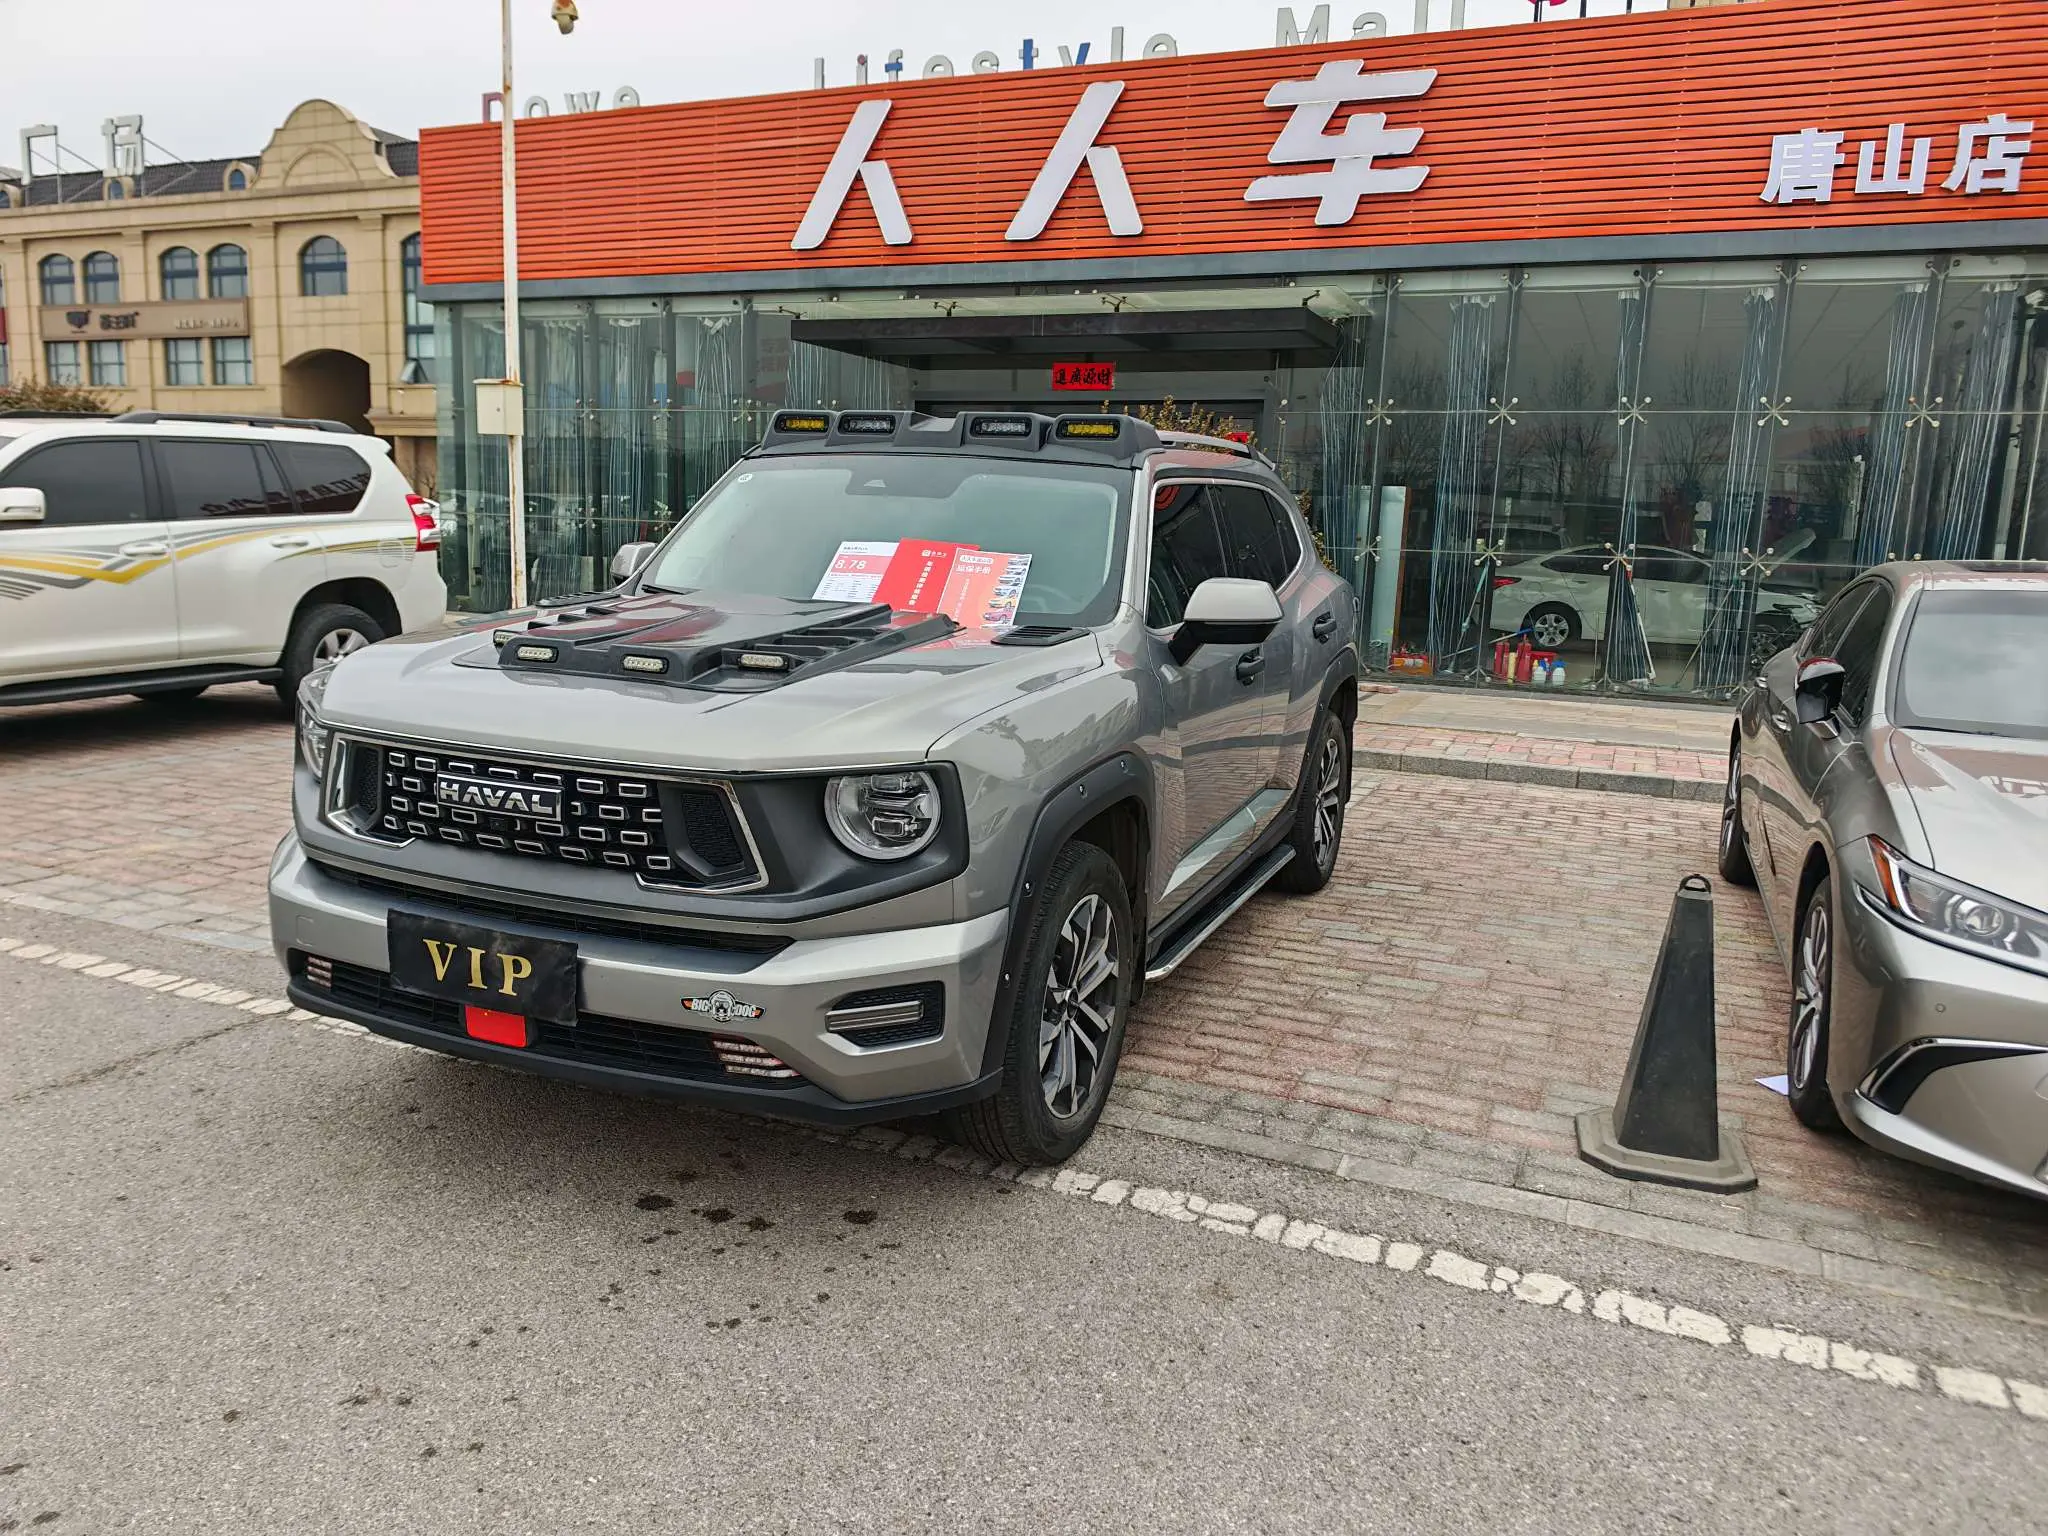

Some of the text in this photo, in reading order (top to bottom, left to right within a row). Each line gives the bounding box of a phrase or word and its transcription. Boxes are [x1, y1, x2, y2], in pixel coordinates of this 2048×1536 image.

[790, 59, 1438, 251] 人人车
[1759, 113, 2035, 204] 唐山店
[835, 559, 867, 570] 8.78
[439, 782, 553, 814] HAVAL
[422, 938, 532, 996] VIP
[691, 998, 757, 1018] BIG DOG
